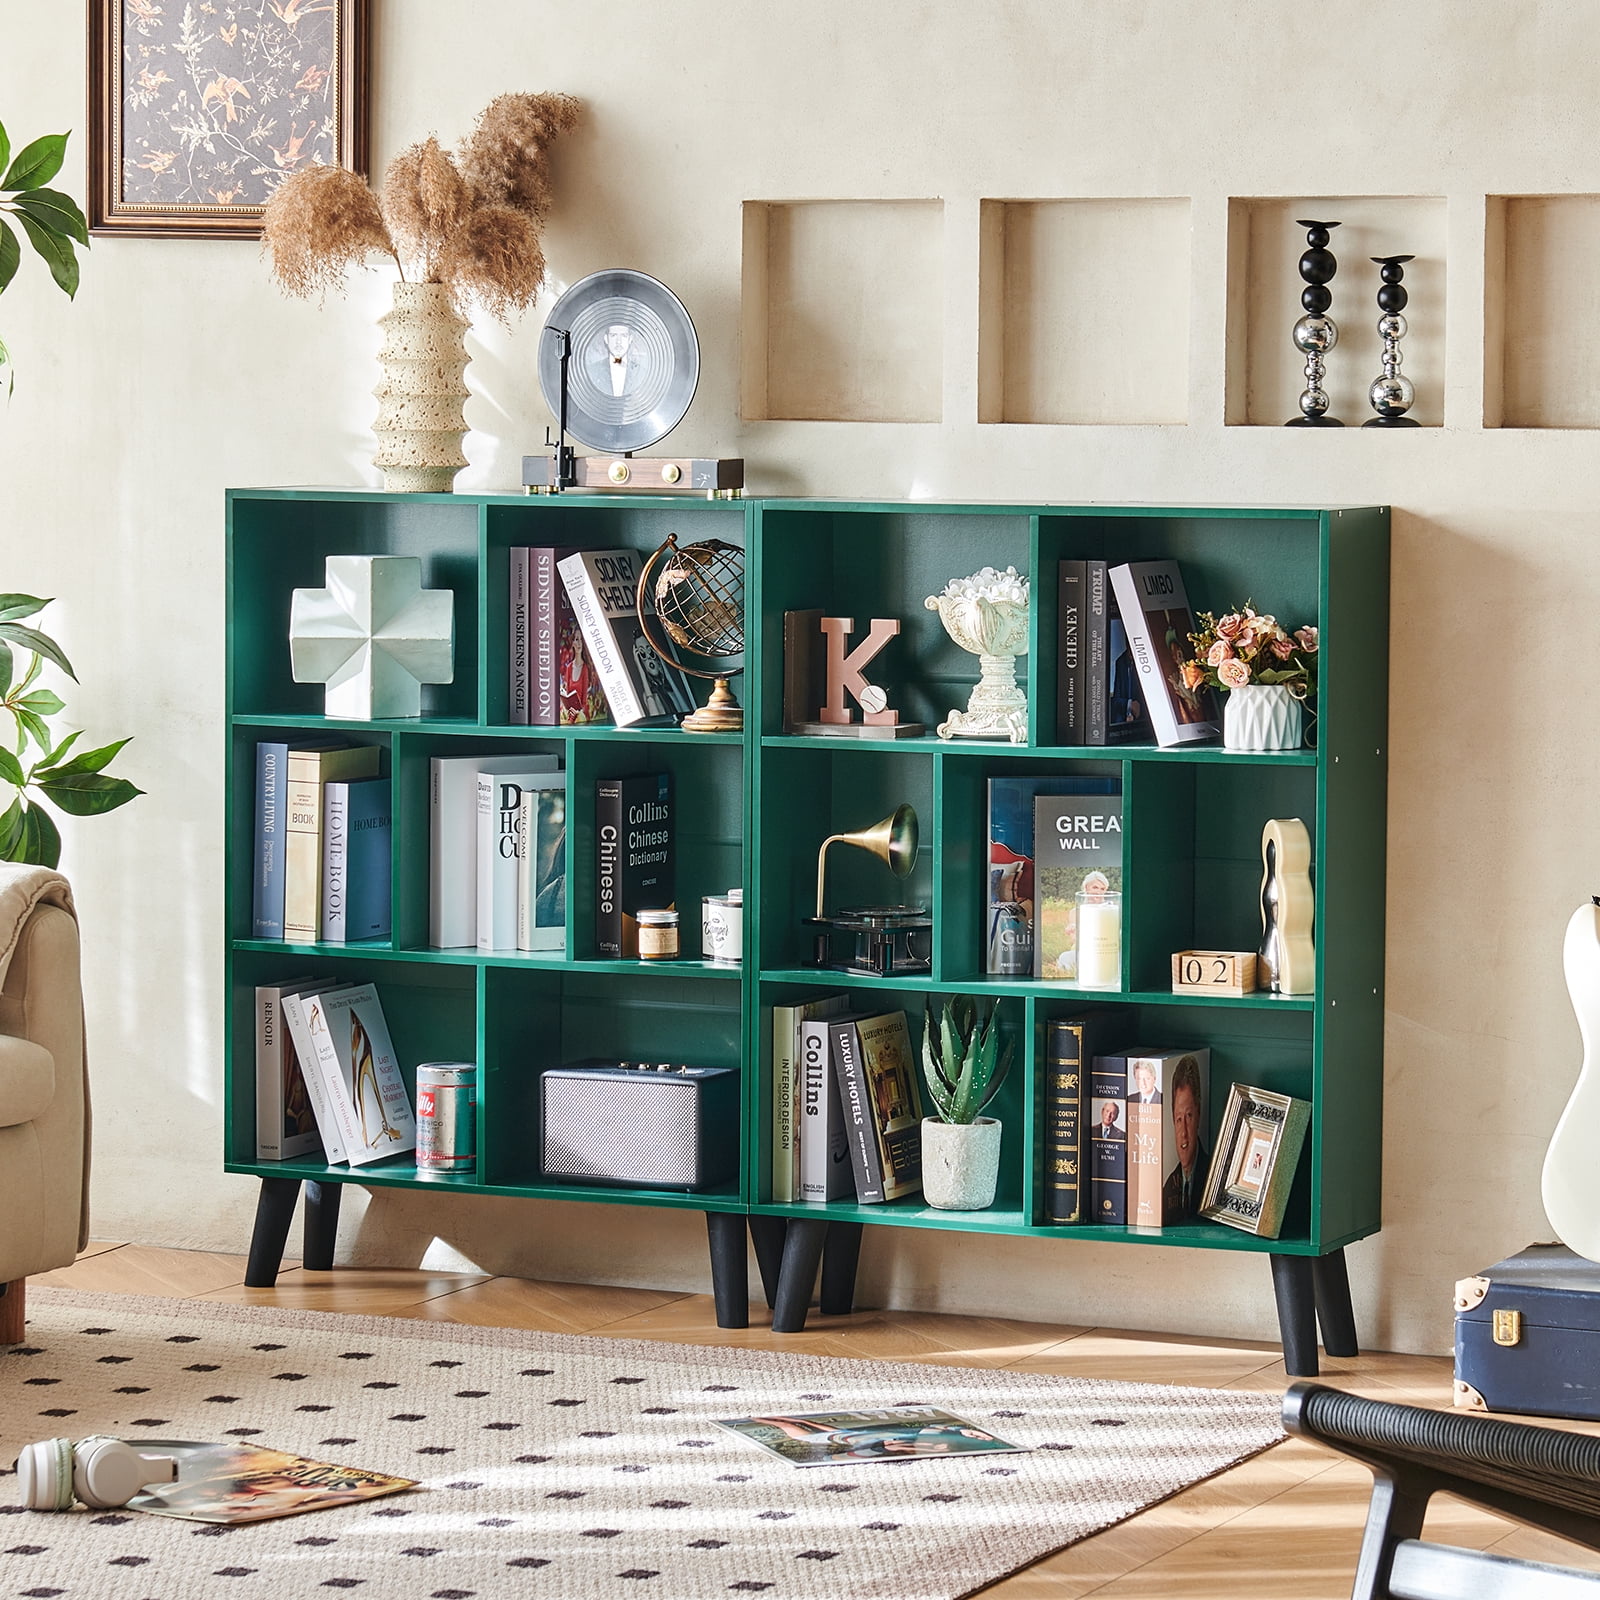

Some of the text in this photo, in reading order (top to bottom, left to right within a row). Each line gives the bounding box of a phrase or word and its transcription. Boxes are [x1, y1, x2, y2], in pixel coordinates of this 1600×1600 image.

[594, 556, 636, 584] SIDNEY
[1092, 568, 1102, 615] TRUMP
[1142, 574, 1174, 596] LIMBO
[538, 556, 550, 717] SIDNEY SHELDON
[577, 594, 596, 628] SIDNEY
[590, 628, 614, 674] SHELDON
[1066, 606, 1078, 668] CHENEY
[516, 604, 524, 714] MUSIKENS ANGEL
[1133, 636, 1152, 674] LIMBO
[820, 617, 900, 726] K
[264, 754, 276, 832] COUNTRY LIVING
[292, 813, 314, 824] BOOK
[354, 818, 378, 831] HOME
[629, 802, 669, 825] Collins
[1056, 816, 1122, 833] GREA
[629, 830, 668, 849] Chinese
[1060, 838, 1100, 850] WALL
[328, 802, 342, 922] HOME BOOK
[600, 826, 617, 914] Chinese
[630, 850, 668, 866] Dictionary
[1001, 930, 1031, 945] Gui
[289, 1002, 298, 1019] LEAN
[264, 1002, 272, 1046] RENOIR
[864, 1021, 902, 1040] LUXURY HOTELS
[306, 1056, 314, 1080] SHERYL
[806, 1035, 822, 1116] Collins
[840, 1032, 864, 1125] LUXURY HOTELS
[331, 1075, 354, 1139] Lauren Weisberger
[1058, 1110, 1078, 1118] COUNT
[1138, 1104, 1152, 1113] Bill
[1134, 1133, 1156, 1150] My
[1132, 1150, 1158, 1164] Life
